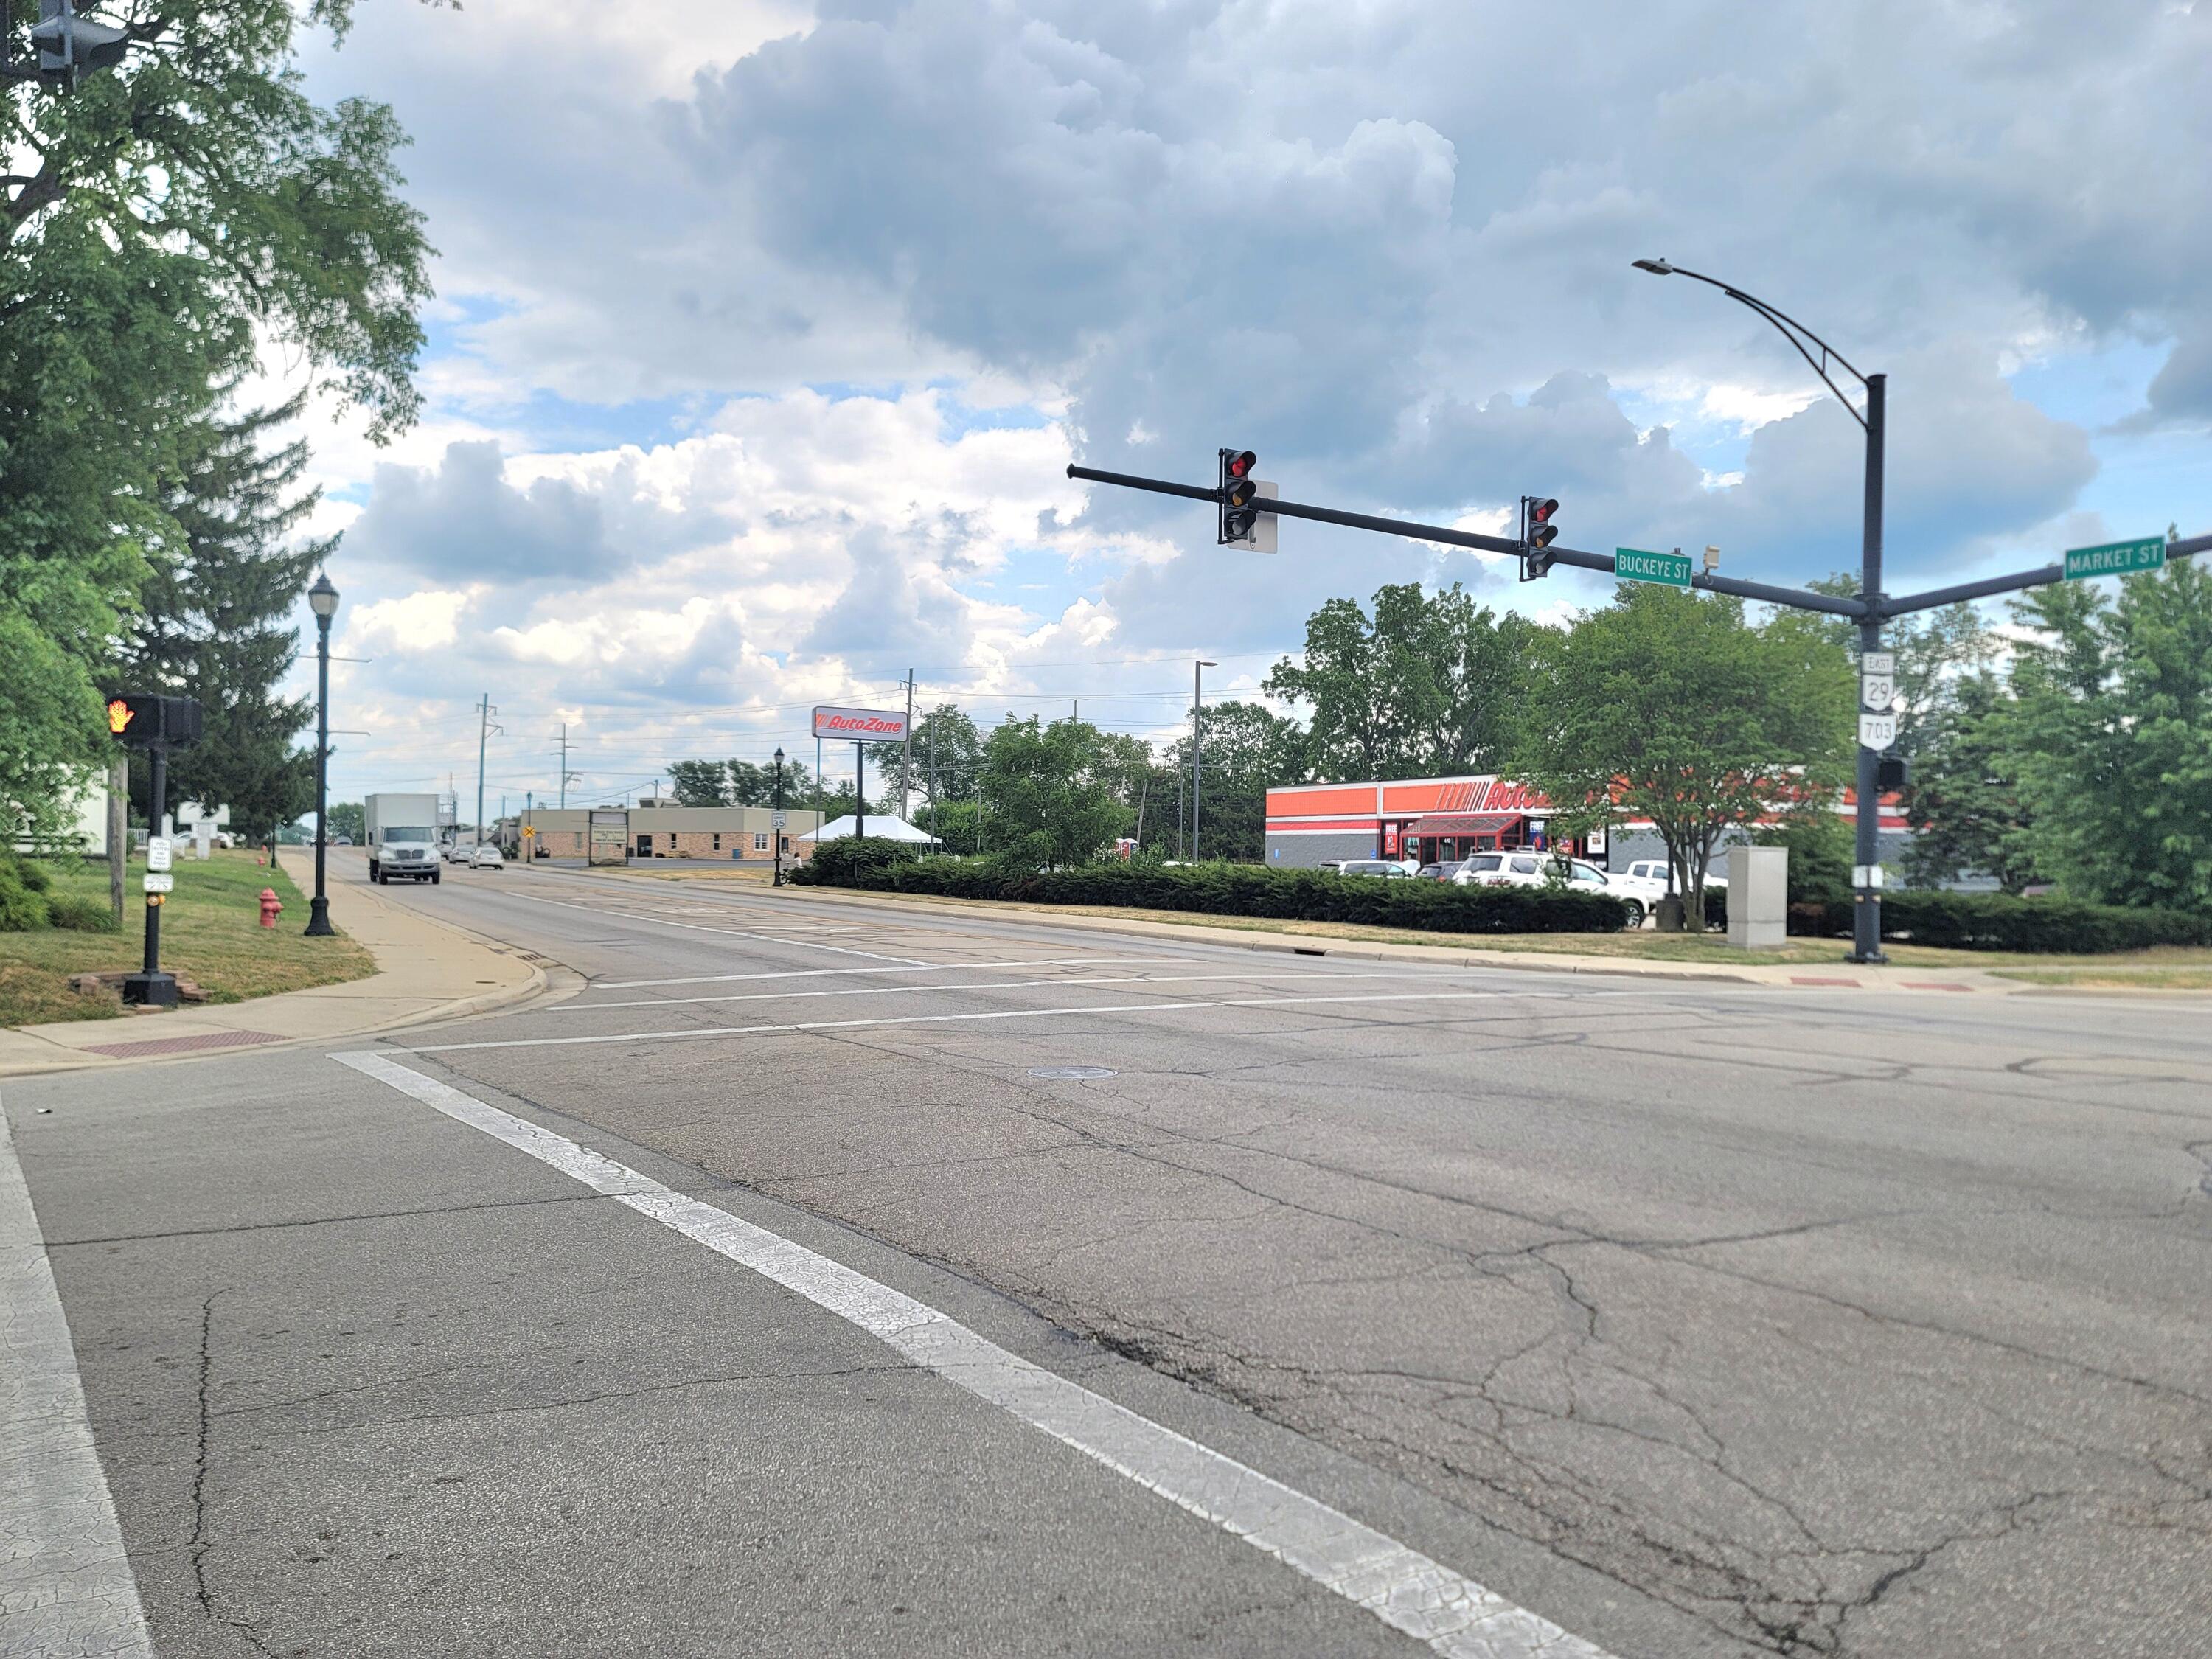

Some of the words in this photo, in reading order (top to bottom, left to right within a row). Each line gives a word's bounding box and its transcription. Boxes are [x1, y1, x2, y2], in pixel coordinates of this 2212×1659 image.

[1618, 554, 1672, 577] BUCKEYE
[1674, 563, 1689, 580] ST
[2069, 546, 2134, 574] MARKET
[2138, 543, 2160, 564] ST
[1868, 682, 1889, 702] 29
[827, 715, 903, 733] AutoZone
[1865, 722, 1892, 740] 703
[1385, 824, 1398, 833] FREE
